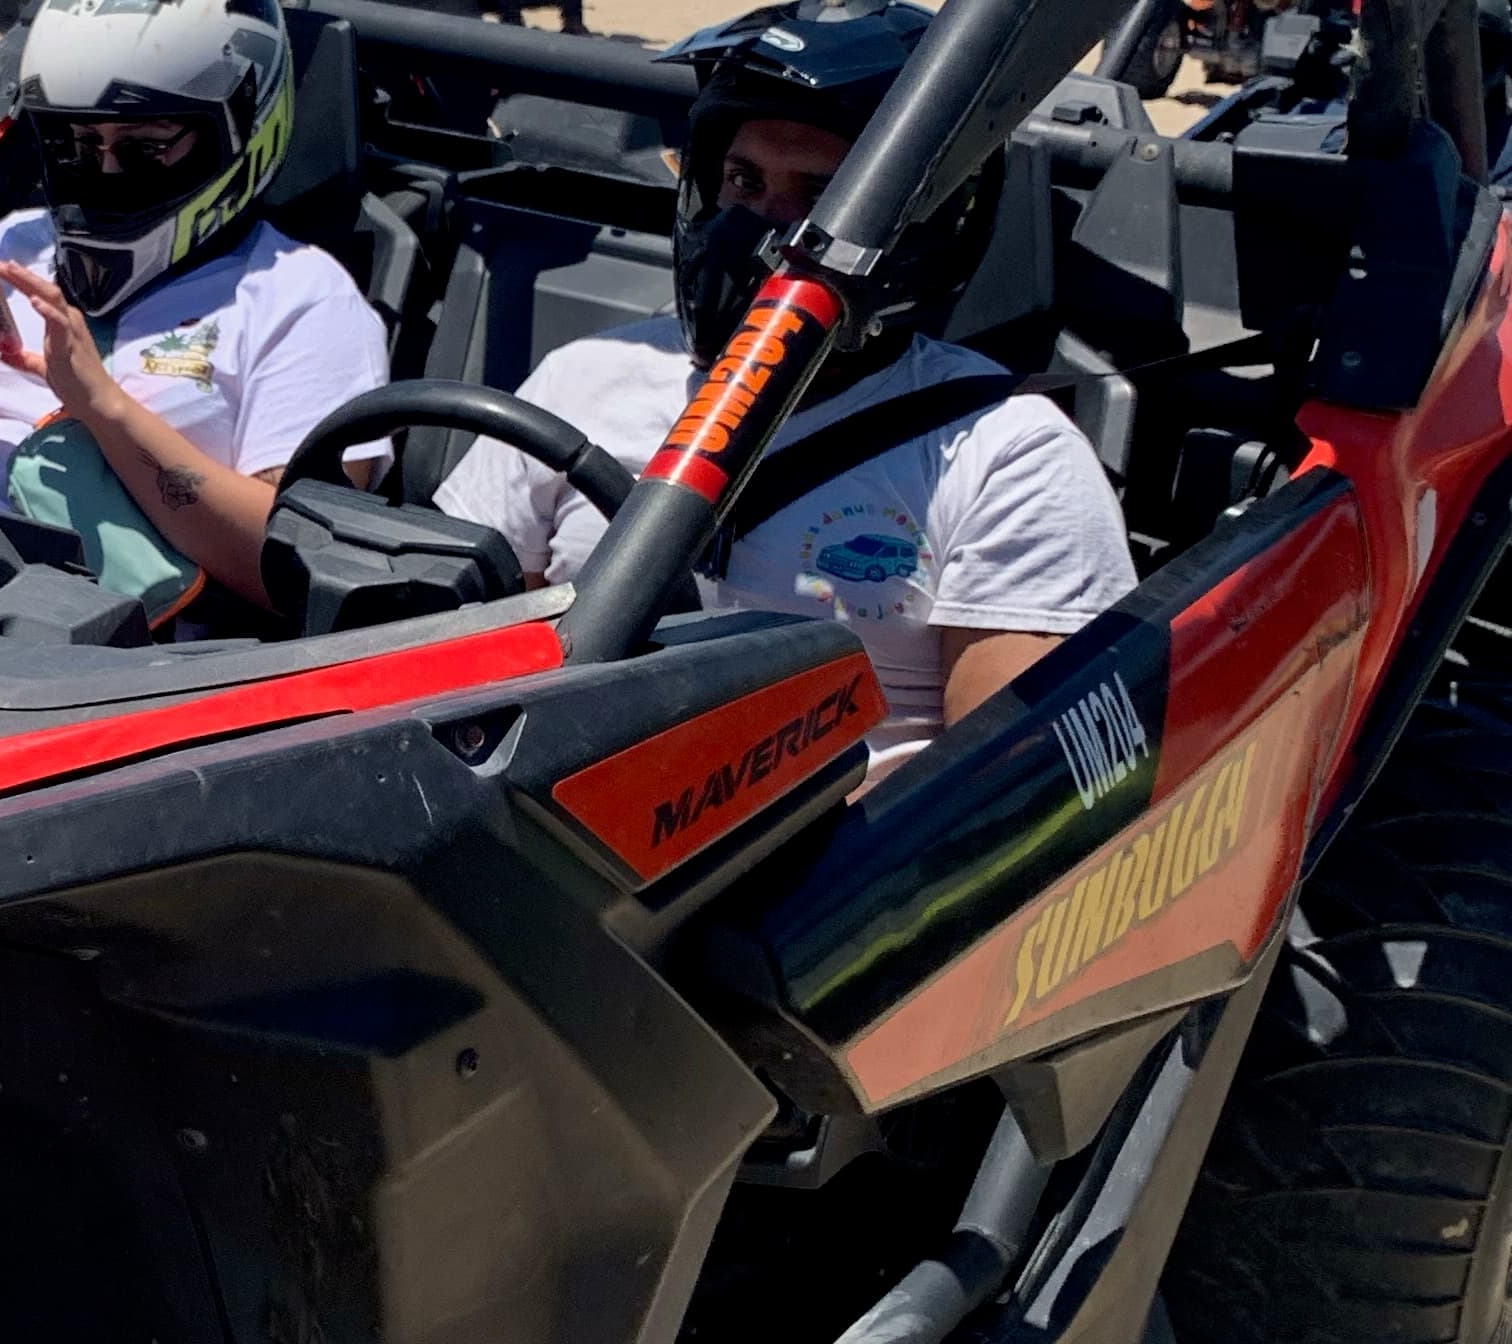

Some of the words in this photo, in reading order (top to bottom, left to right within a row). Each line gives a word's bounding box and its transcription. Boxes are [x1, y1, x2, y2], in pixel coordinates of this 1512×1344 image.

[665, 307, 806, 453] UM204
[652, 673, 863, 849] MAVERICK
[1052, 671, 1149, 811] UM204
[1003, 741, 1256, 1027] SUNBUGGY
